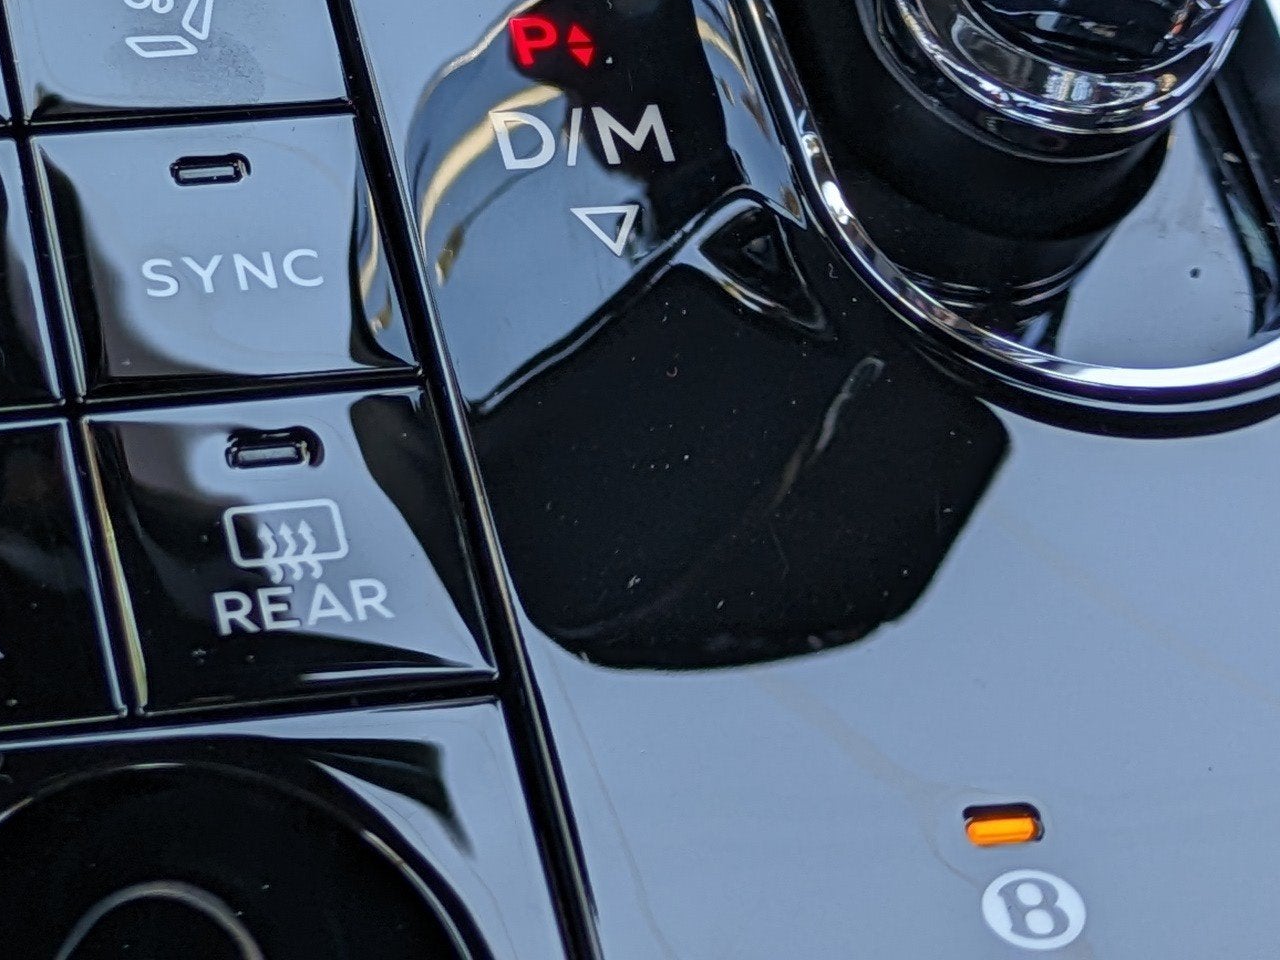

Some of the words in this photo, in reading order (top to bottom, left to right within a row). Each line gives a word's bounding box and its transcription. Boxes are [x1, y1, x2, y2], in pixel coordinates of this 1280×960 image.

[508, 16, 558, 67] P
[489, 103, 676, 171] D/M
[141, 248, 325, 298] SYNC
[211, 577, 396, 635] REAR
